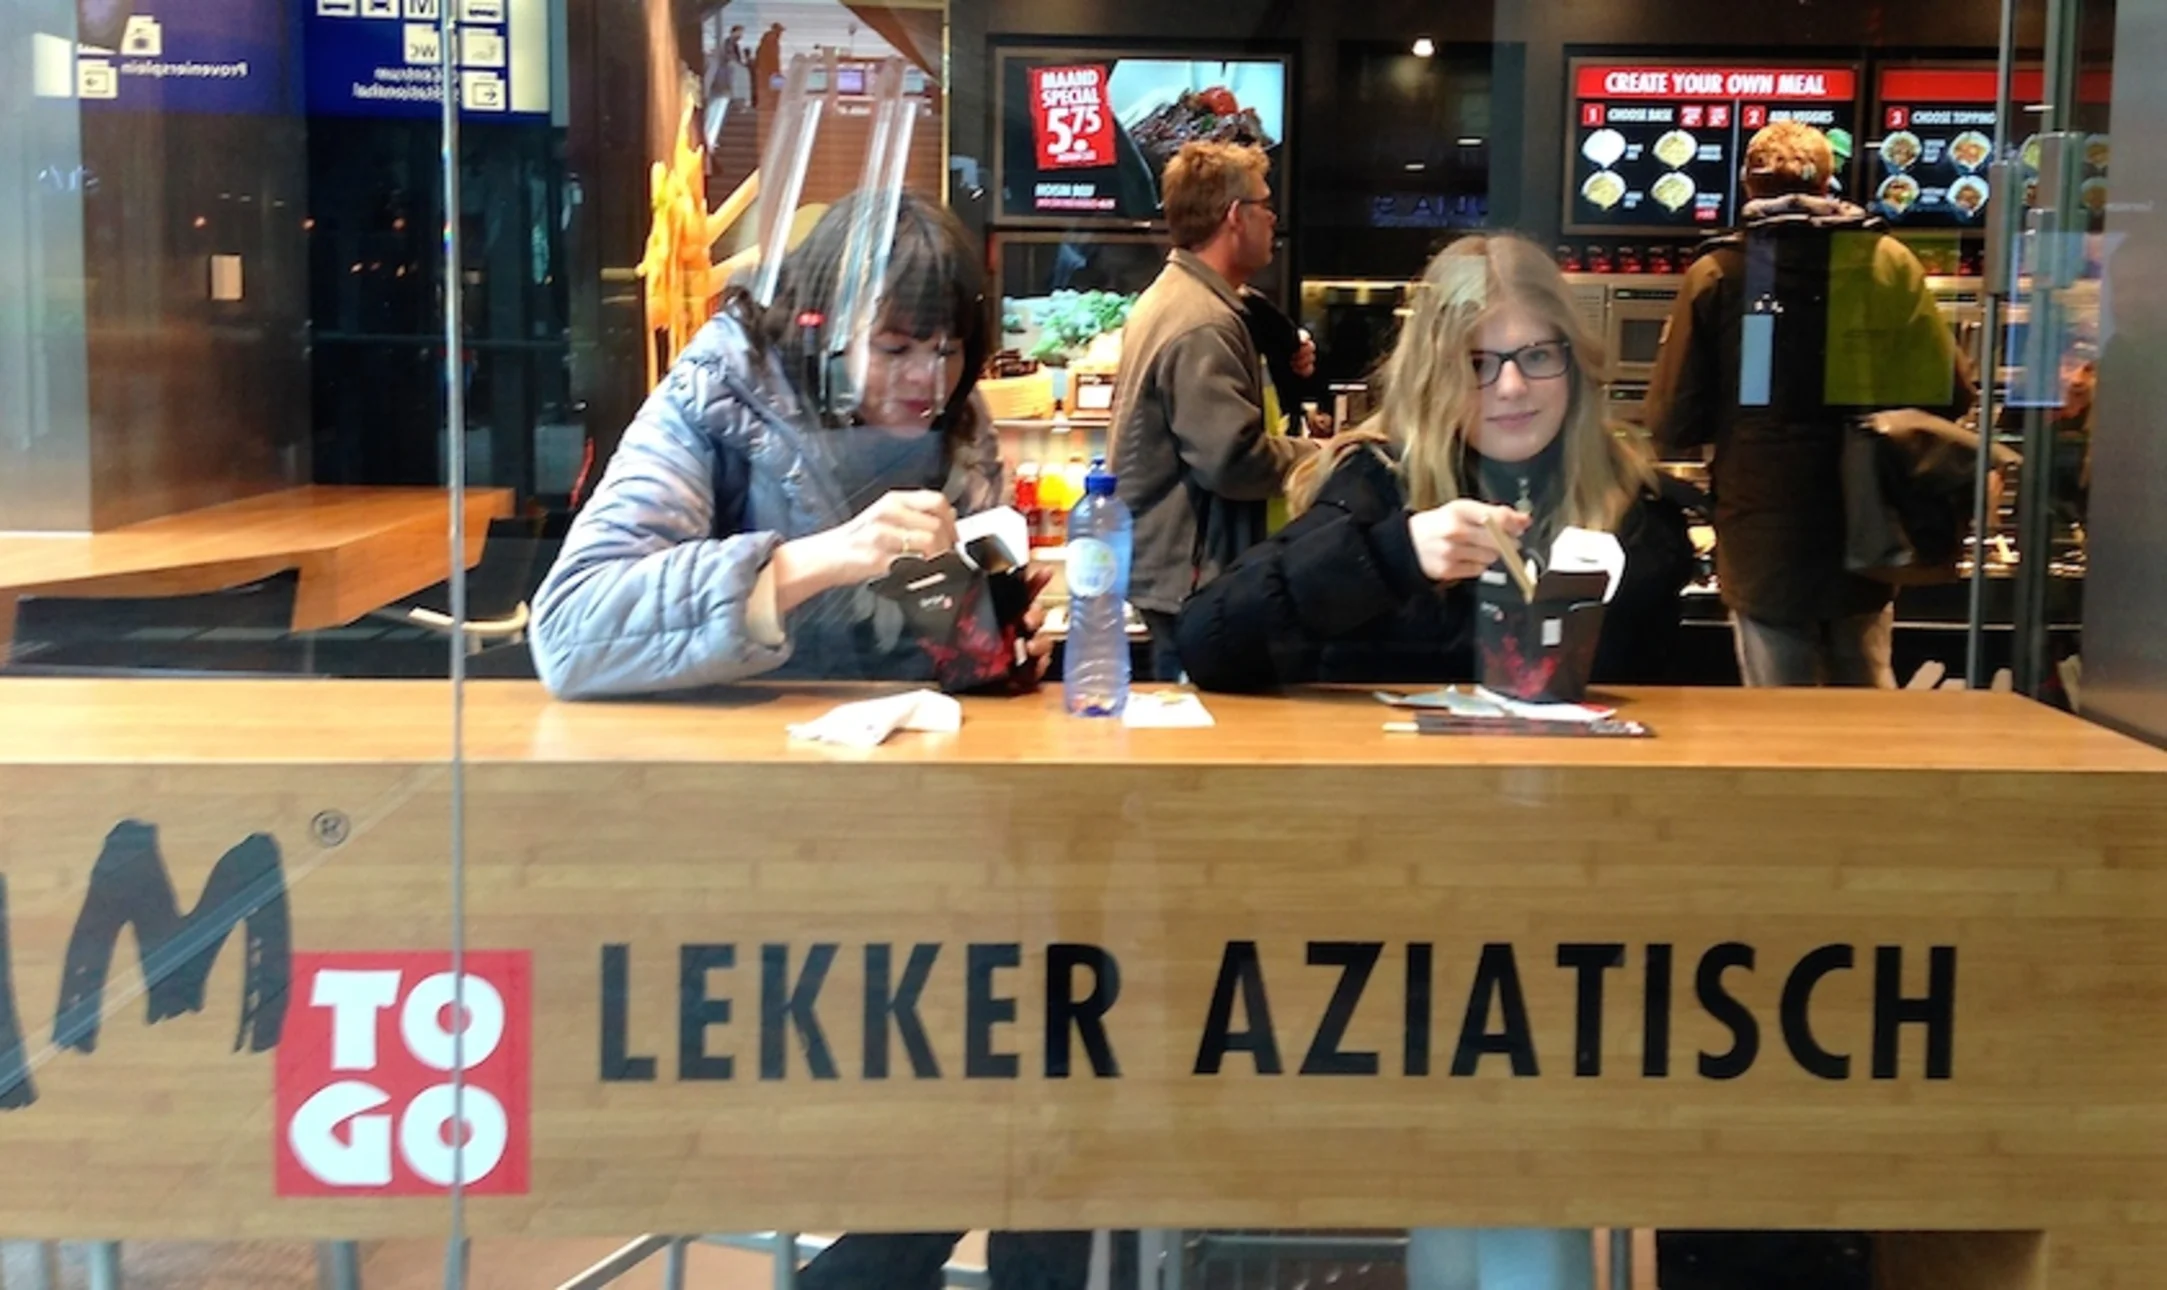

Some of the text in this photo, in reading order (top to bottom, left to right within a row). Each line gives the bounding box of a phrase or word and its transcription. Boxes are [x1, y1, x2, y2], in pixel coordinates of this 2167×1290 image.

[1041, 69, 1099, 88] MAAND
[1605, 72, 1825, 94] CREATE YOUR OWN MEAL
[1041, 87, 1101, 108] SPECIAL
[1911, 110, 1951, 124] CHOOSE
[310, 969, 505, 1071] TO
[600, 940, 1957, 1081] LEKKER AZIATISCH
[288, 1081, 508, 1186] GO
